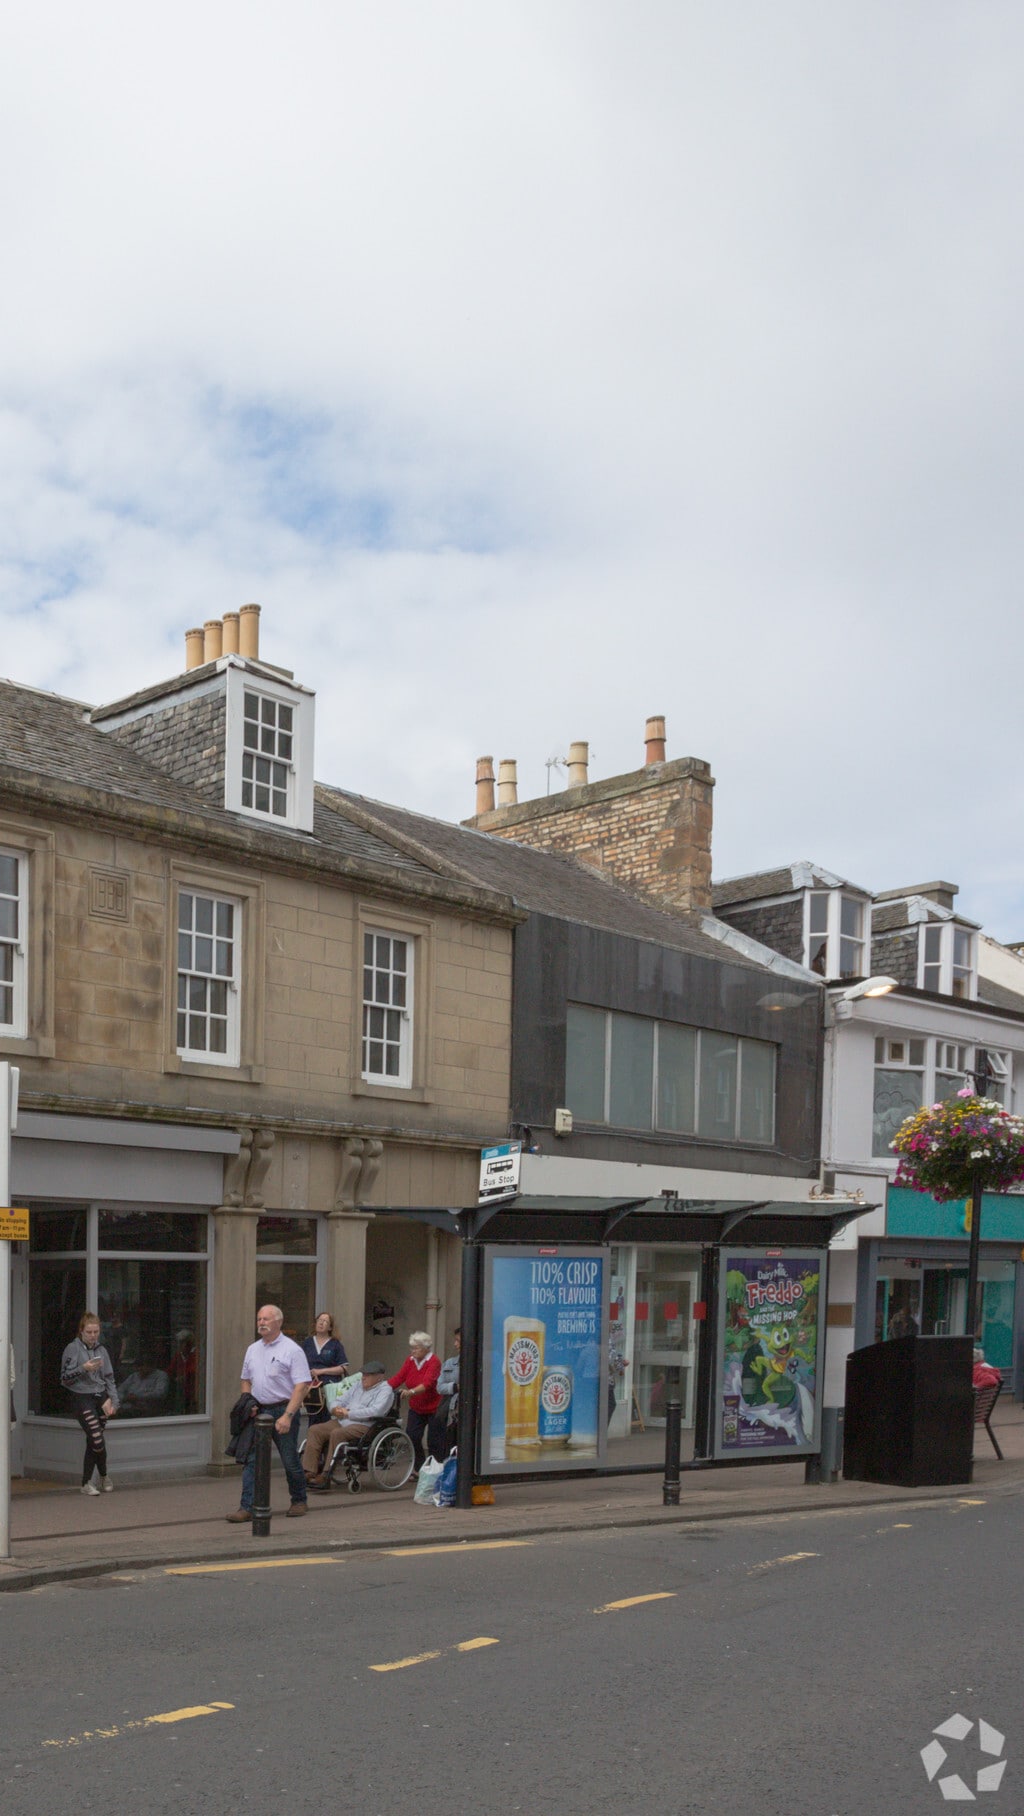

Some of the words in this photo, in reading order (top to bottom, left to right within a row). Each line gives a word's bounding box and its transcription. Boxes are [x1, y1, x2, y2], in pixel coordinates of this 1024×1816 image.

[483, 1178, 496, 1187] Bus
[498, 1175, 515, 1184] Stop
[530, 1261, 564, 1285] 110%
[566, 1261, 598, 1285] CRISP
[530, 1287, 557, 1305] 110%
[558, 1287, 597, 1305] FLAVOUR
[746, 1280, 803, 1308] Freddo
[753, 1311, 782, 1325] MISSING
[557, 1319, 587, 1334] BREWING
[589, 1319, 596, 1334] IS
[544, 1418, 567, 1426] LAGER
